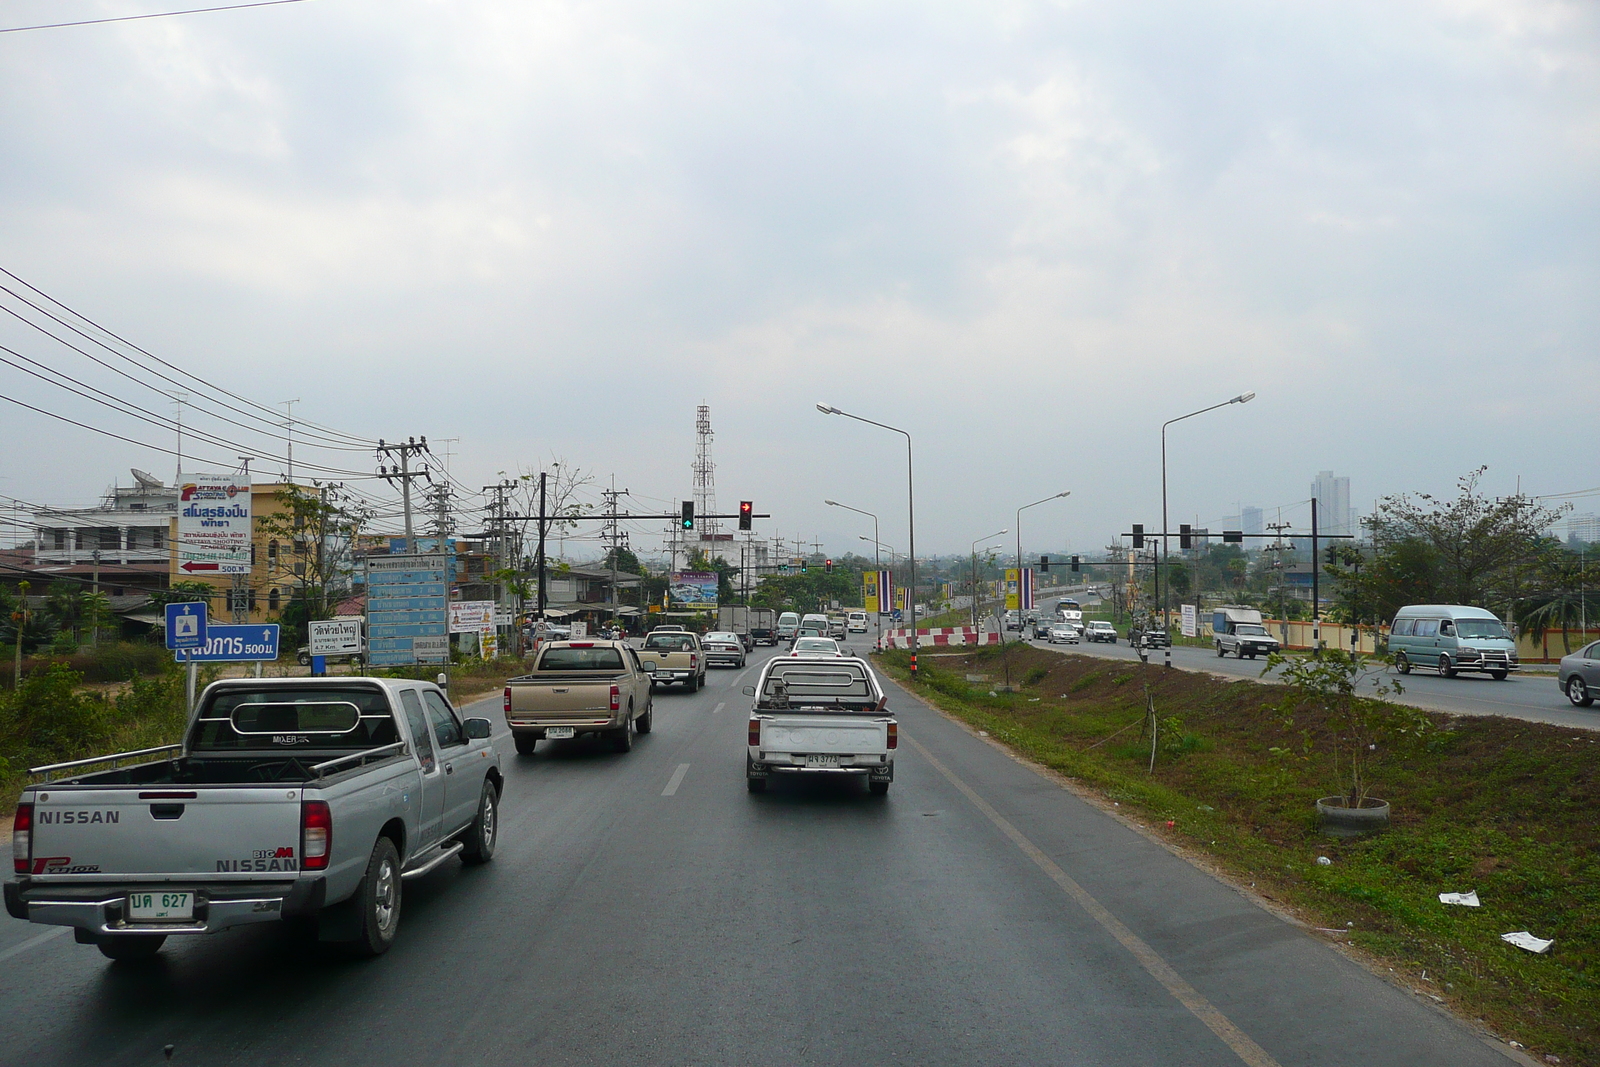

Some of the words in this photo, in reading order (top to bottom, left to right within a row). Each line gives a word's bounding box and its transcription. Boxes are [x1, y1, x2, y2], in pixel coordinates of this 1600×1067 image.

[183, 503, 247, 518] สโมสรยิงปืน
[201, 518, 230, 527] พัทยา
[774, 729, 872, 746] TOYOTA
[820, 755, 838, 763] 3773
[39, 810, 120, 824] NISSAN
[216, 858, 298, 873] NISSAN
[162, 894, 188, 908] 627
